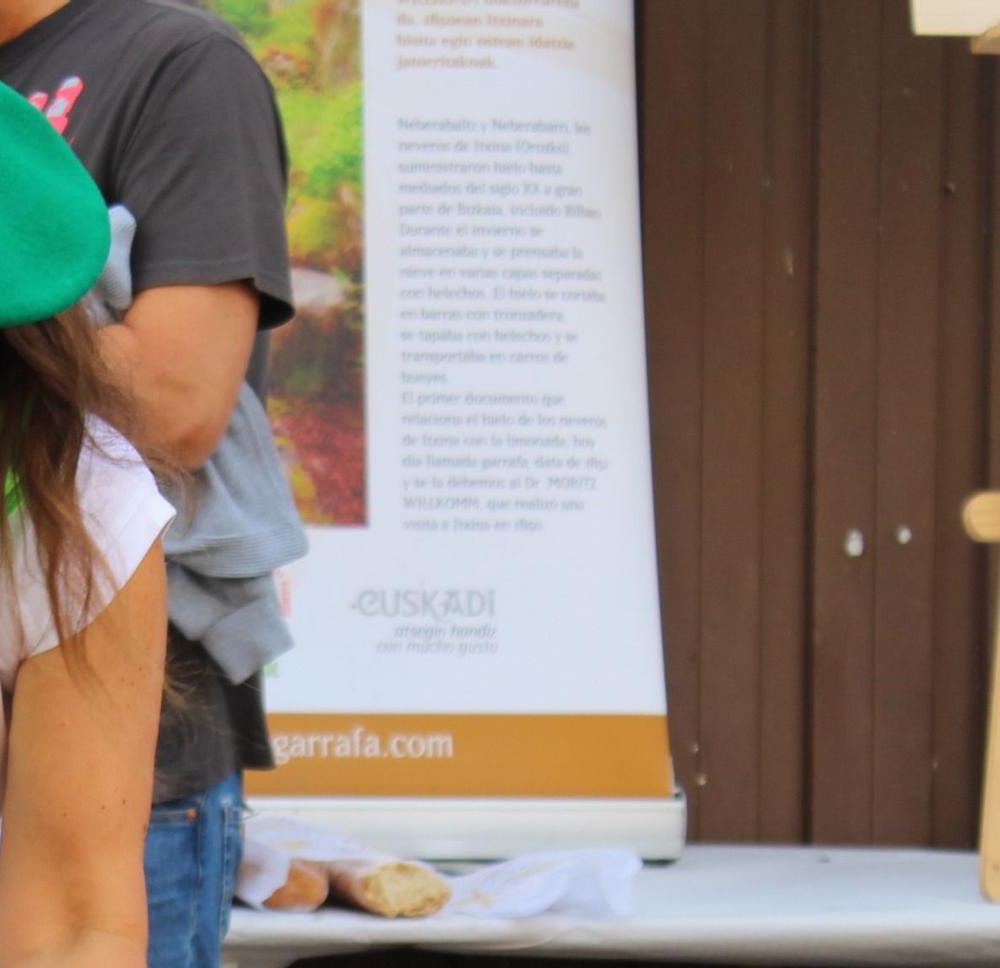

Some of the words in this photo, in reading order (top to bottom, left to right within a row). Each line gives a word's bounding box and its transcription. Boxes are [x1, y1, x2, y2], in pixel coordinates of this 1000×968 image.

[400, 289, 425, 299] con
[466, 310, 490, 321] con
[466, 332, 491, 342] con
[462, 437, 488, 447] con
[376, 642, 402, 656] con
[407, 640, 454, 655] mucho
[458, 641, 499, 658] gusto
[273, 727, 454, 764] garrafa.com
